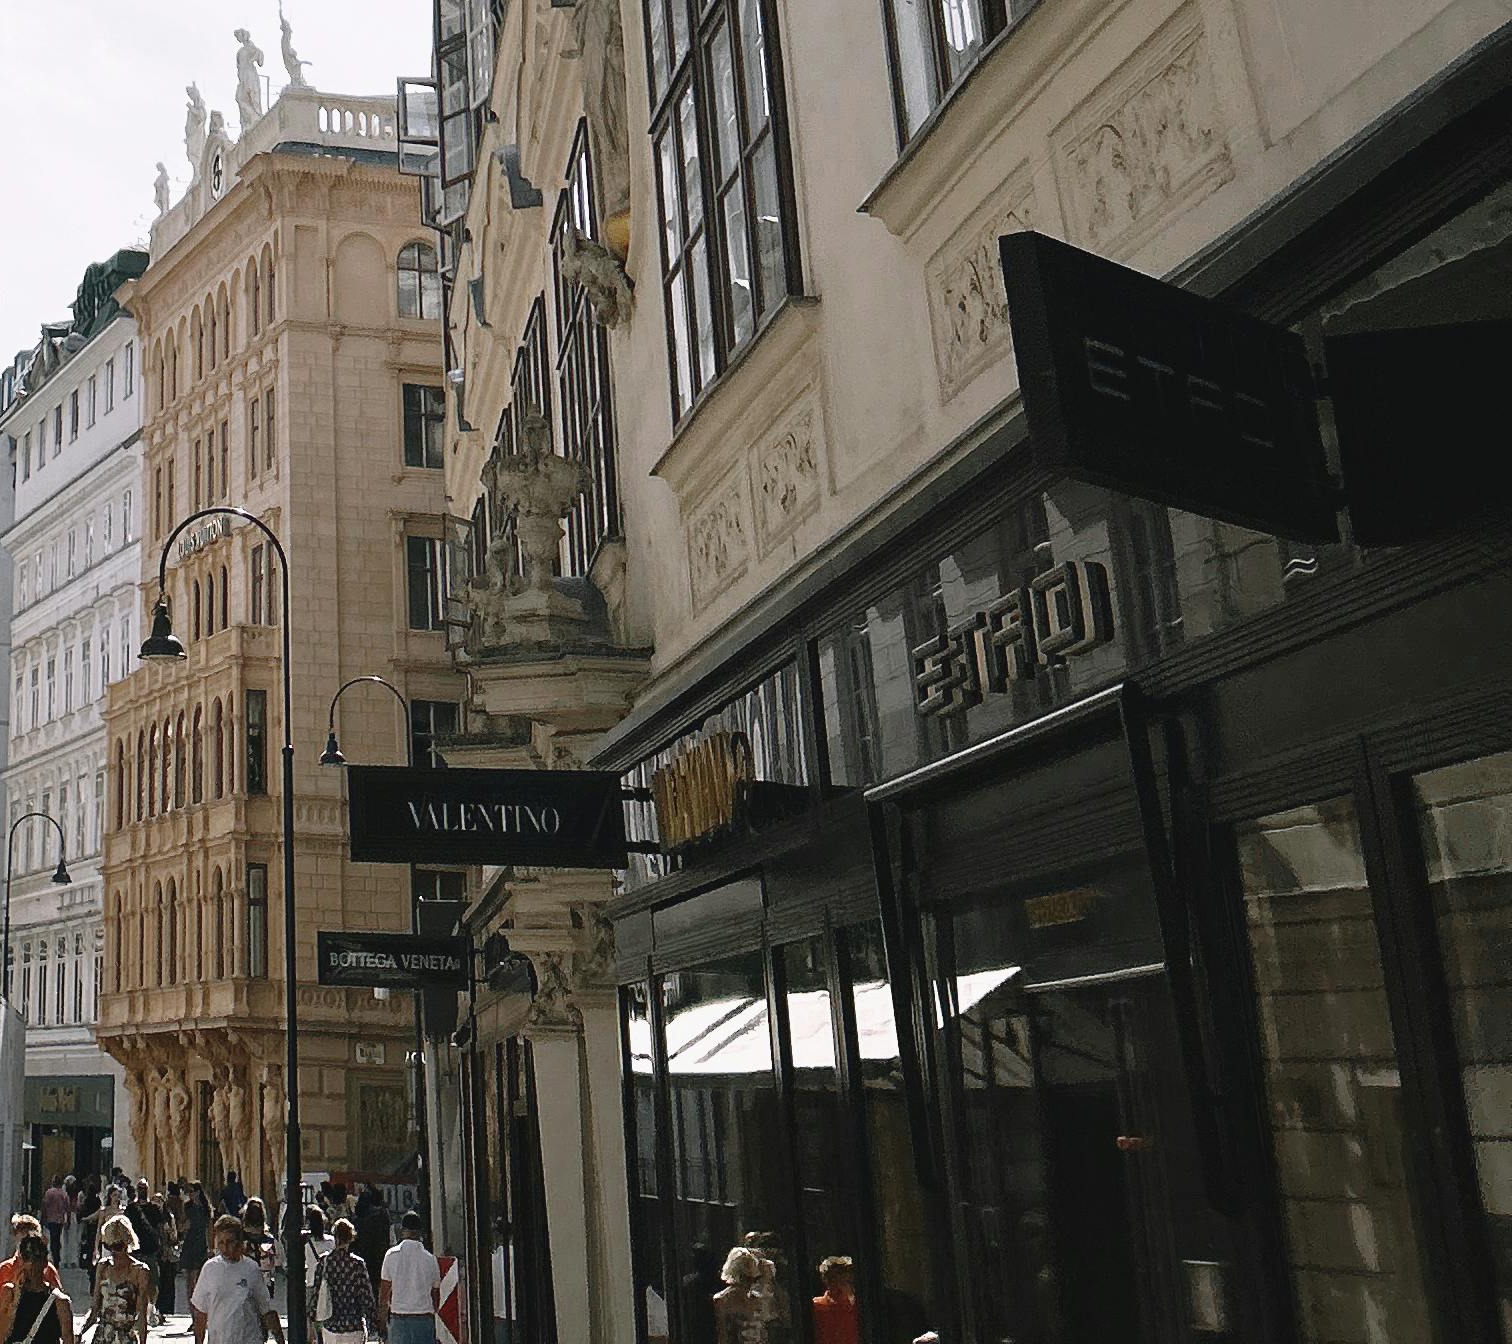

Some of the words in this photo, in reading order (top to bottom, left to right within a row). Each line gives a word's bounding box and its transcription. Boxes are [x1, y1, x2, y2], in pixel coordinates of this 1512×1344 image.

[407, 800, 561, 834] VALENTINO
[329, 952, 398, 969] BOTTEGA
[400, 954, 460, 971] VENETA
